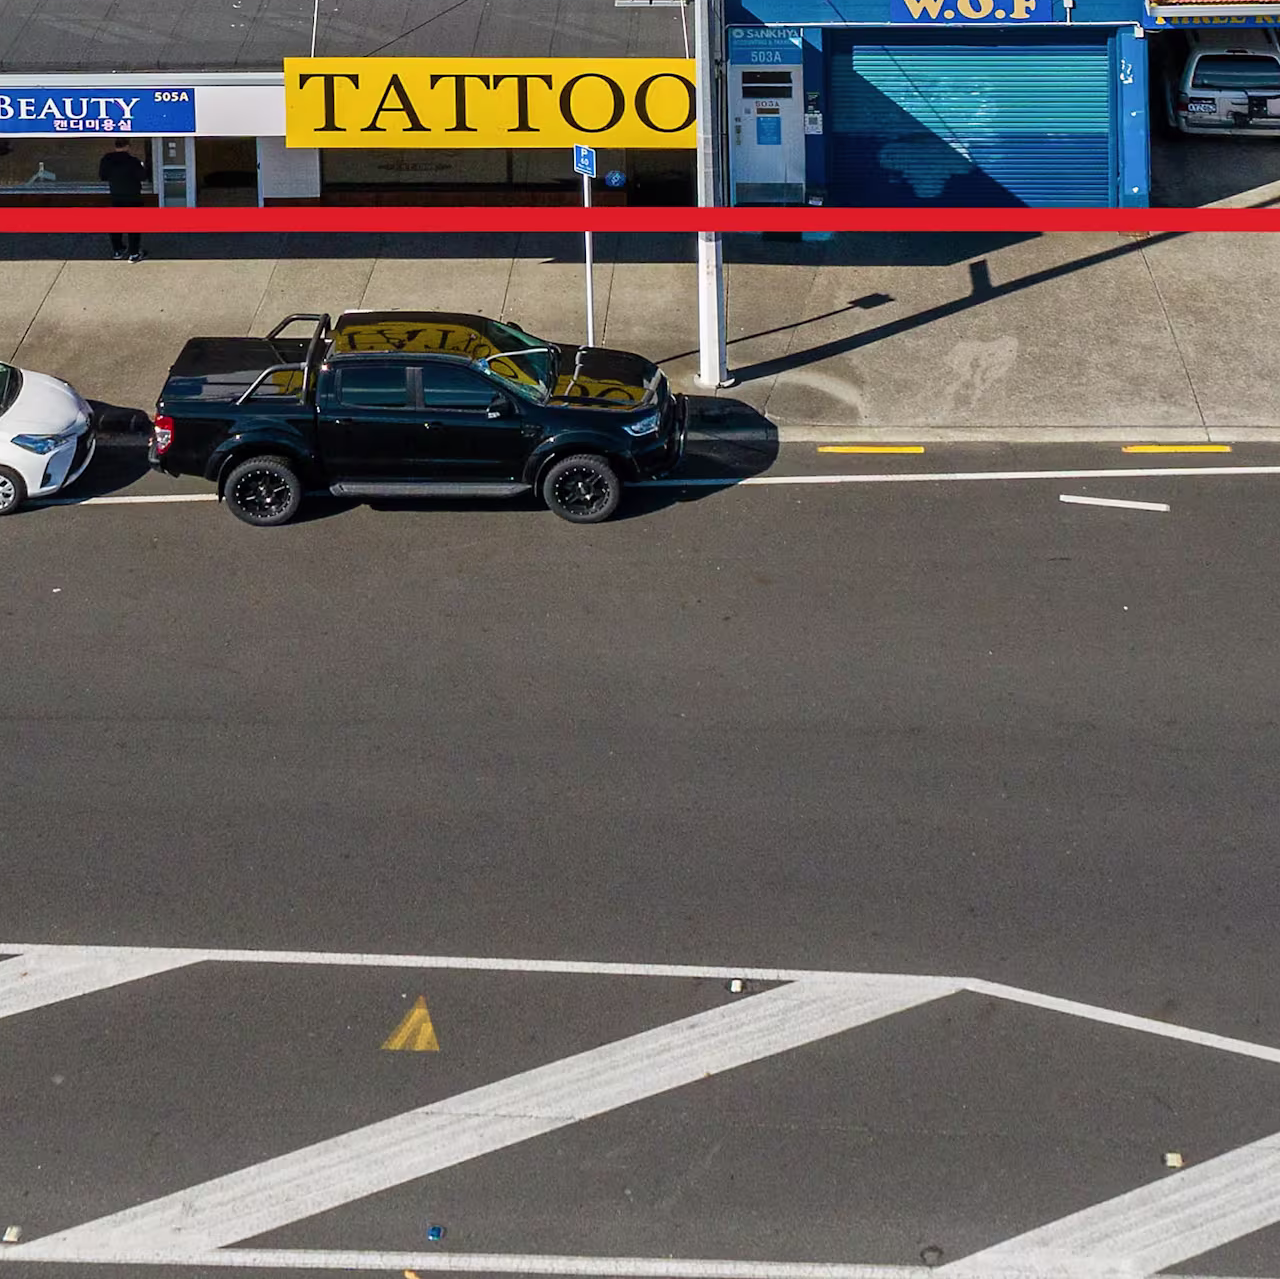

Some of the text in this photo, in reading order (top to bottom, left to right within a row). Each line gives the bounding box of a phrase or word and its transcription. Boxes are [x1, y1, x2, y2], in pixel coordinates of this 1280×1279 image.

[751, 51, 782, 63] 503A
[154, 91, 190, 103] 505A
[298, 72, 696, 134] TATTOO
[53, 118, 133, 132] 캔디미용실
[581, 148, 588, 157] P
